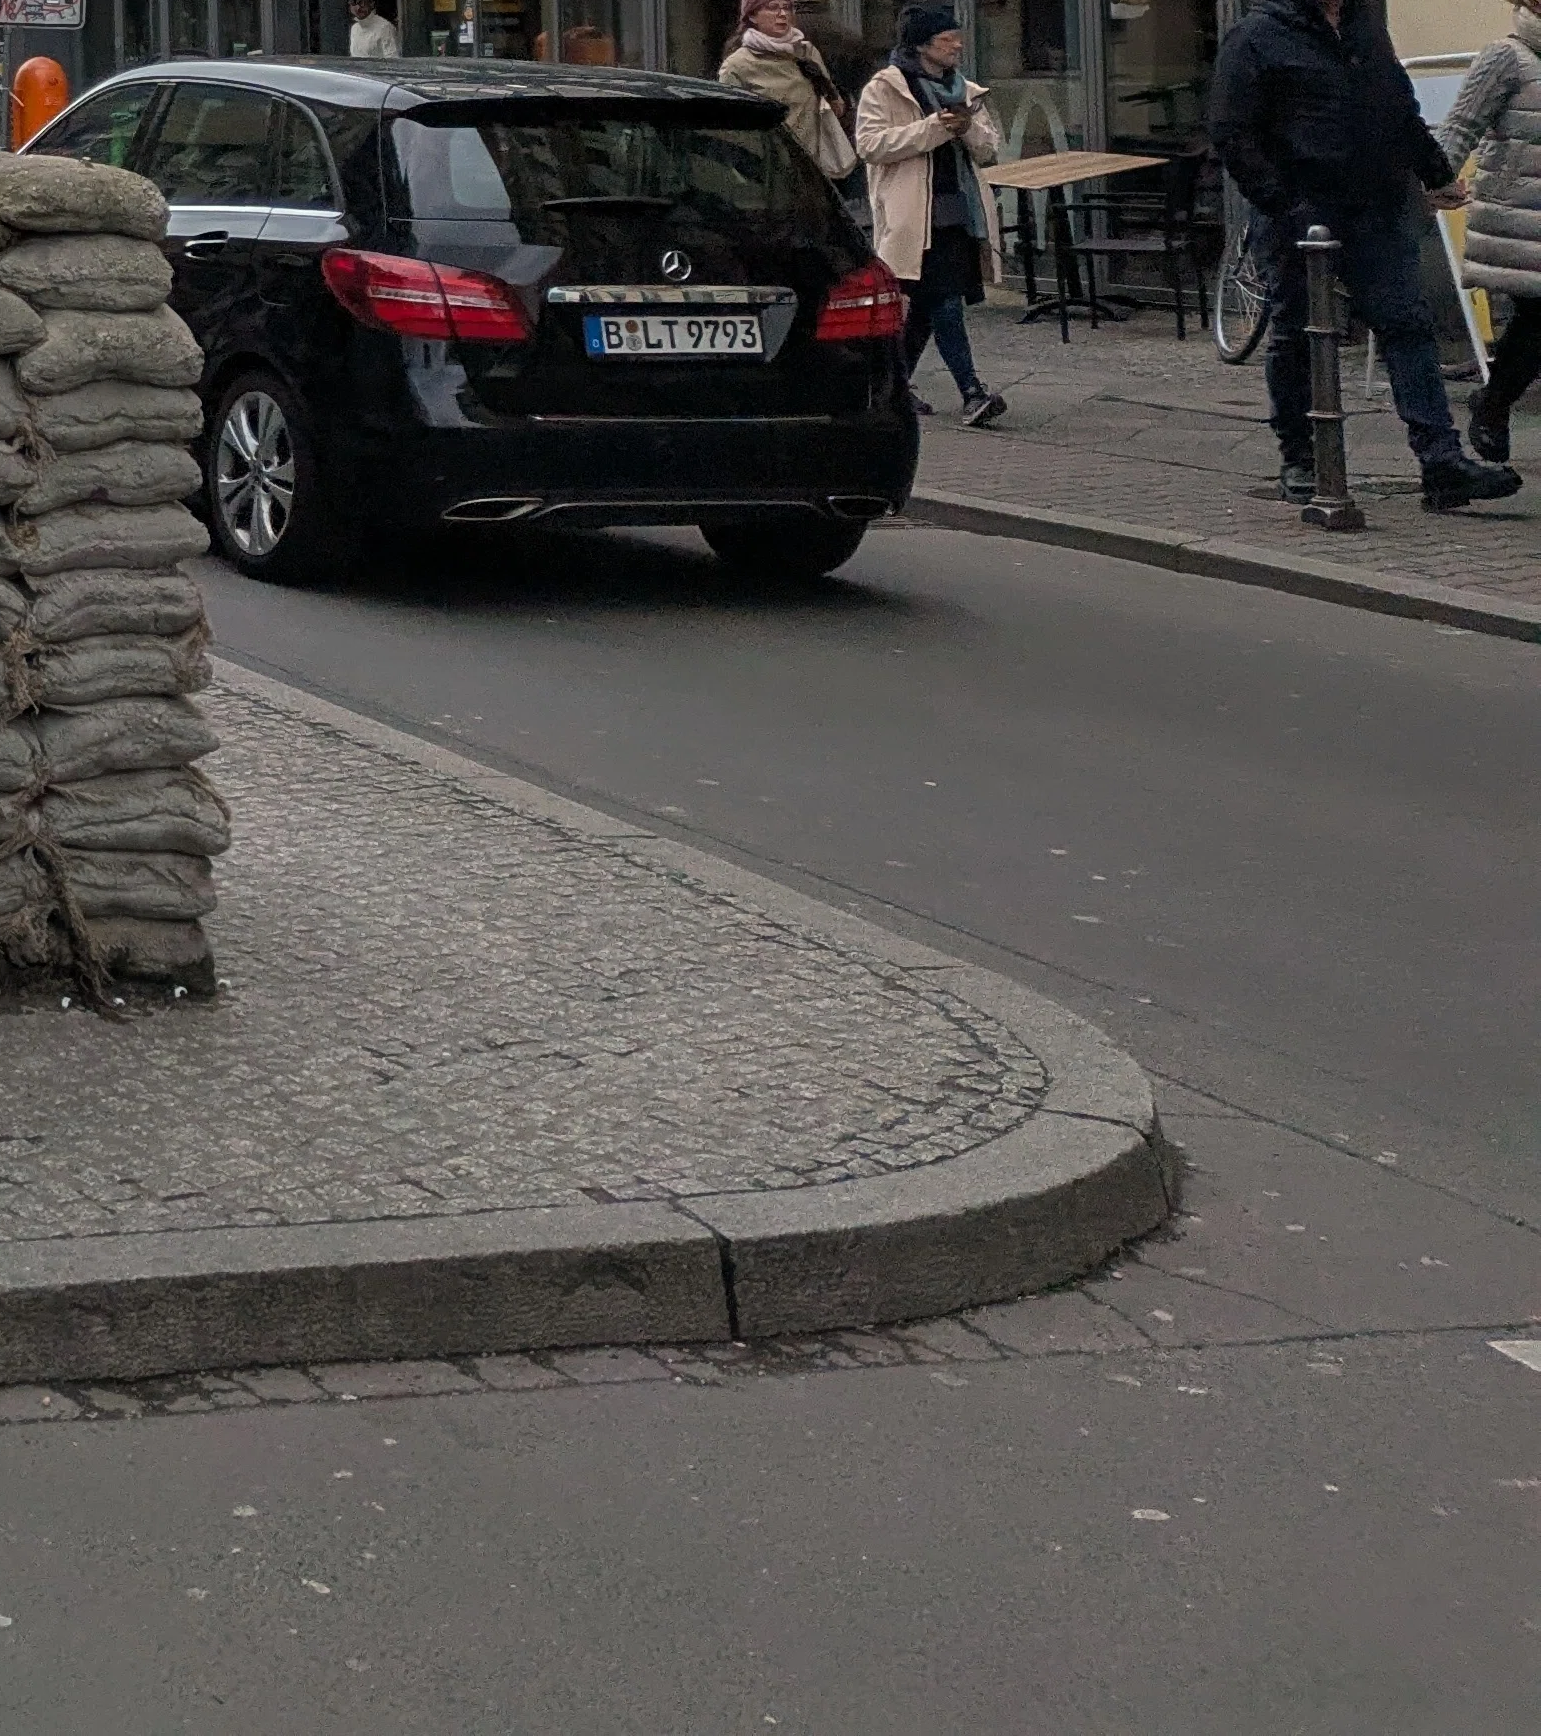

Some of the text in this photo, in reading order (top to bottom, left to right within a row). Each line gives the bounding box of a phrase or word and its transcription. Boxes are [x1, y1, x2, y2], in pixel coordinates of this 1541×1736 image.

[604, 318, 758, 349] B LT 9793
